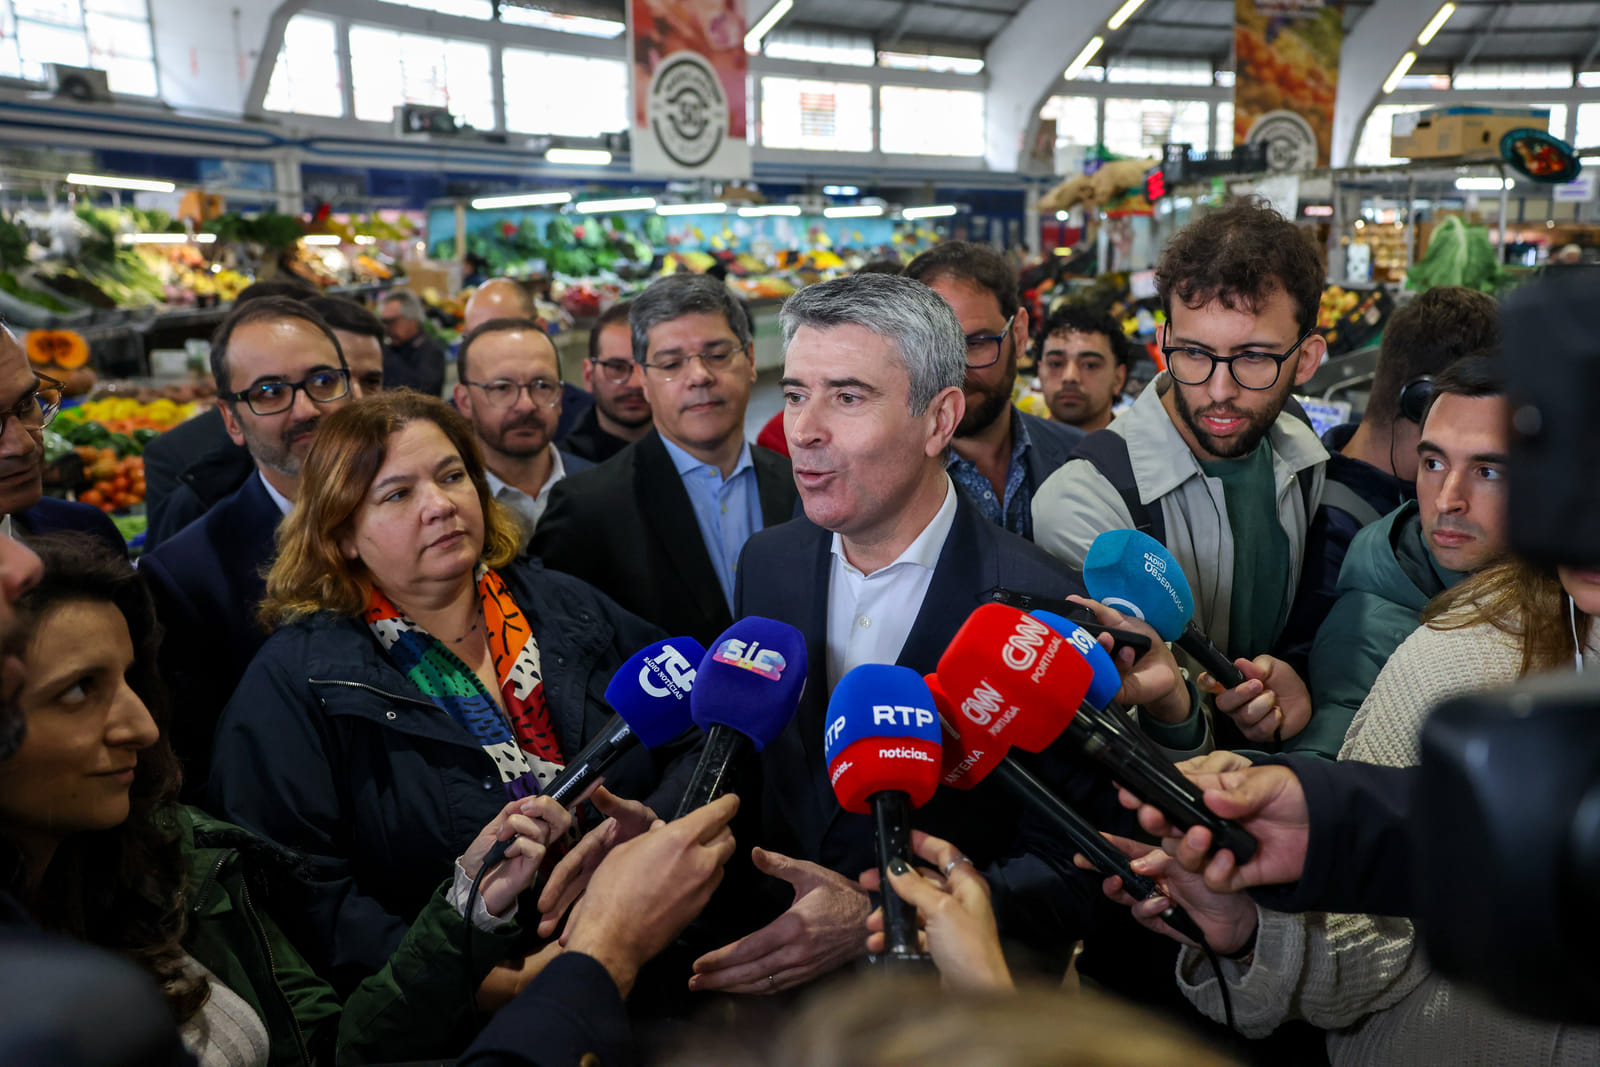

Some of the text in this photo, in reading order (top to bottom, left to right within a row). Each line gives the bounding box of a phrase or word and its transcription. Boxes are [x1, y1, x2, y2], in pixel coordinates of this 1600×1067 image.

[1002, 615, 1049, 671] CNN
[1031, 636, 1063, 684] PORTUGAL
[658, 670, 684, 700] NOTÍCIAS
[961, 680, 1005, 726] CNN
[872, 705, 934, 727] RTP
[944, 749, 985, 784] ANTENA
